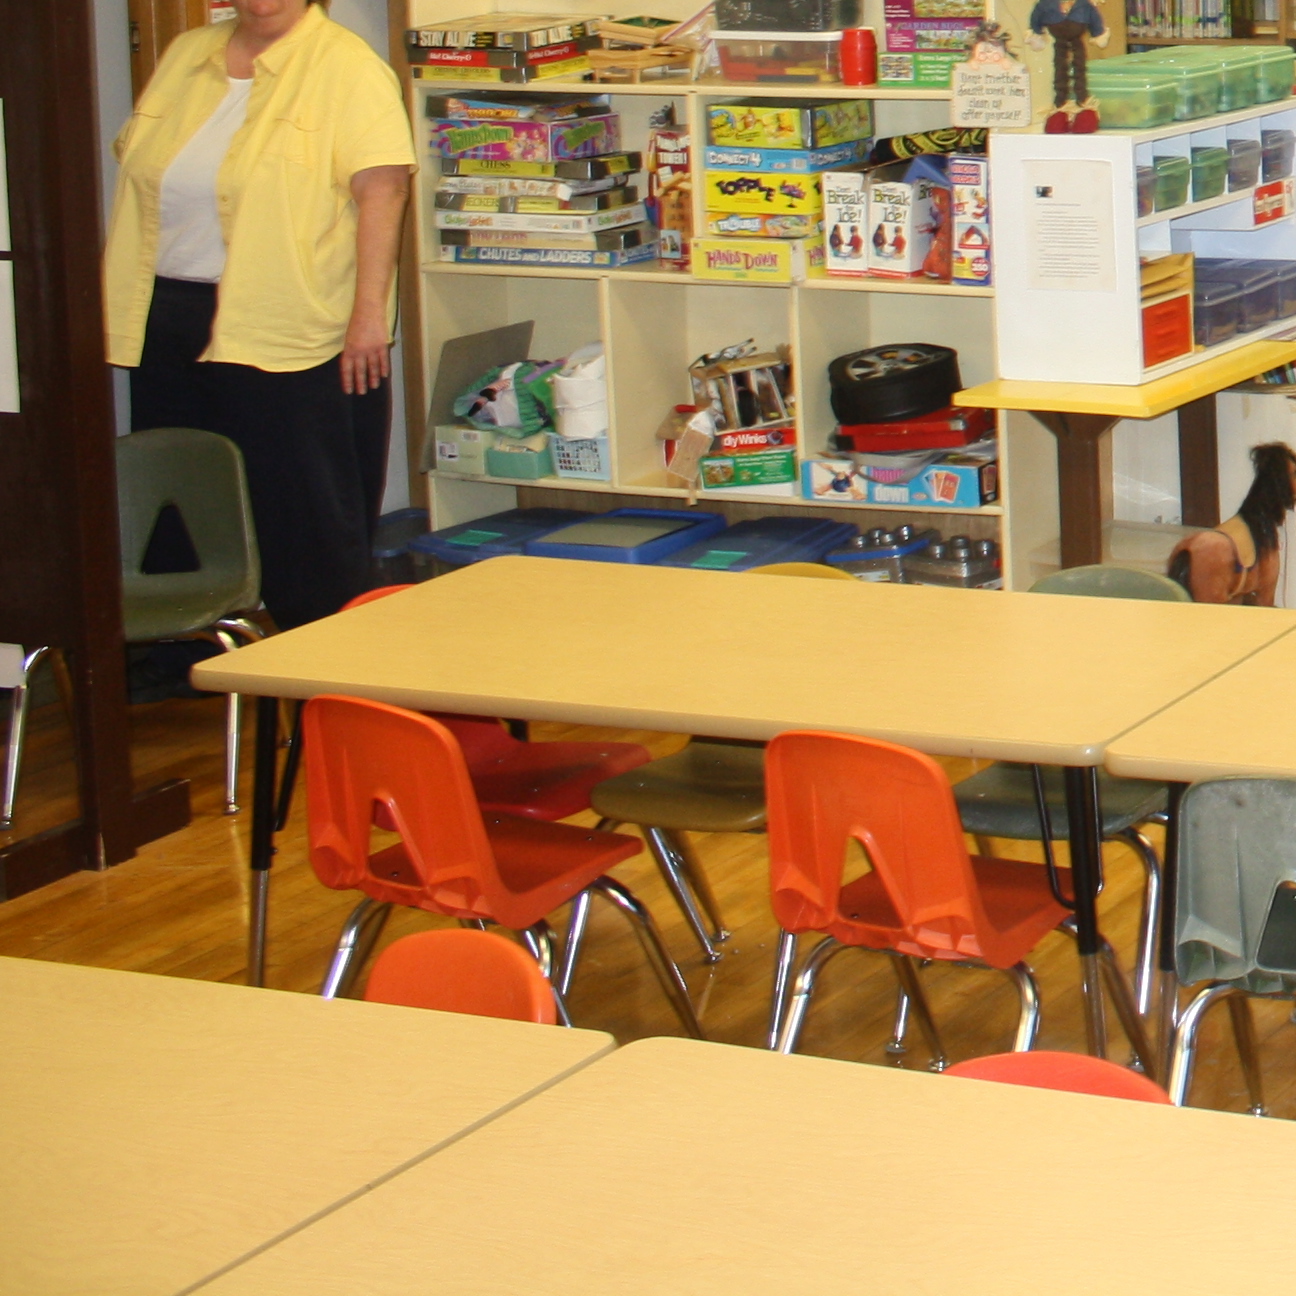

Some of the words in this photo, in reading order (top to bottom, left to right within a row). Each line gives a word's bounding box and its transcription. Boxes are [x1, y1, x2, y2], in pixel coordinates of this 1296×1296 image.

[420, 30, 444, 47] STAY
[715, 177, 776, 202] TOPPLE
[827, 189, 865, 204] Break
[873, 189, 910, 206] Break
[838, 208, 862, 223] Ice!
[884, 208, 907, 224] Ice!
[479, 247, 521, 261] CHUTES
[521, 253, 540, 261] AND
[540, 250, 593, 264] LADDERS
[705, 249, 742, 269] HANDS
[743, 252, 779, 270] DOWN
[875, 485, 909, 503] down
